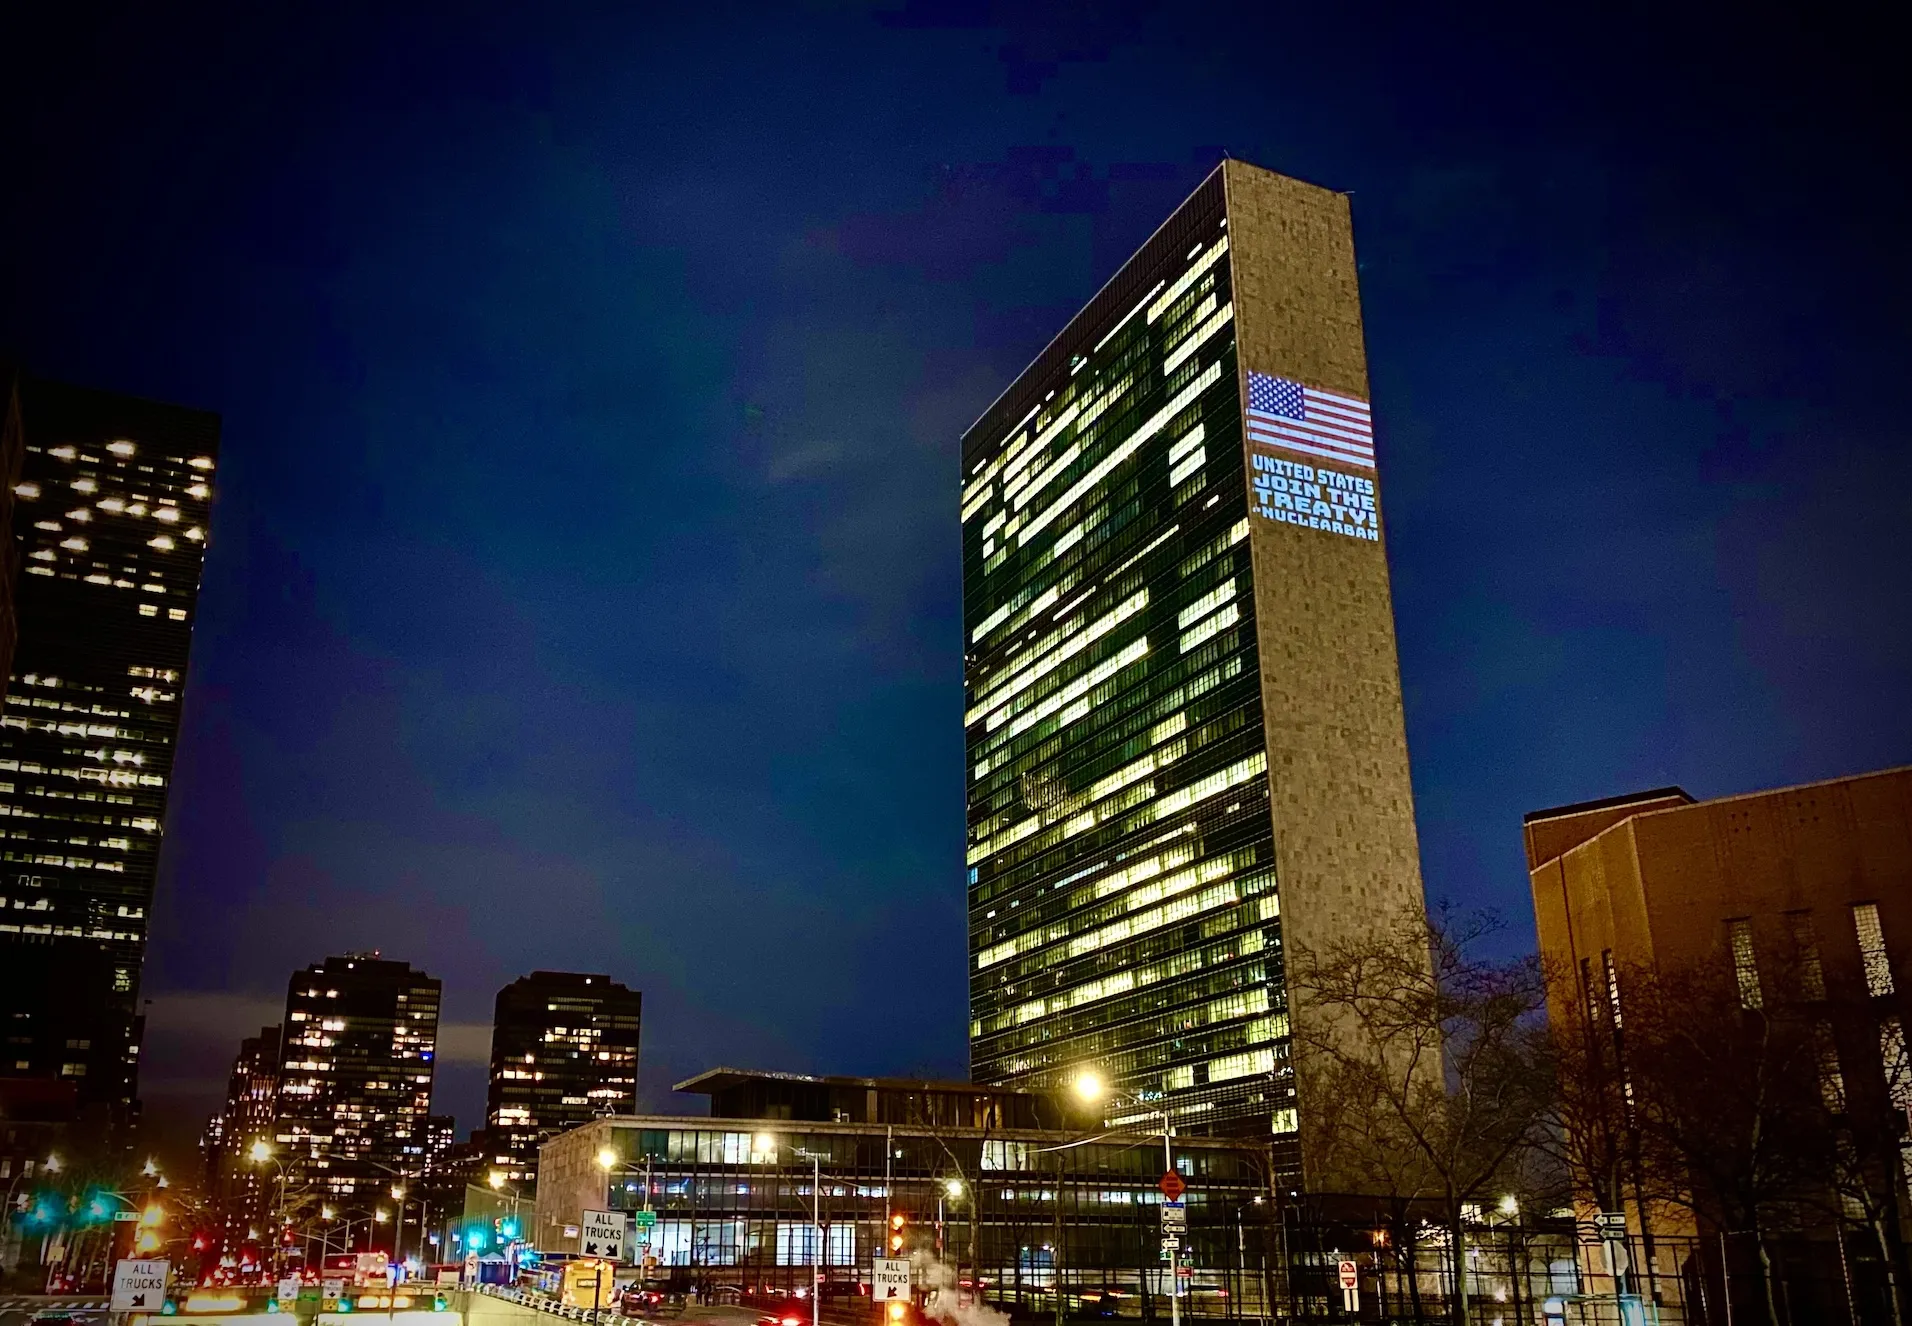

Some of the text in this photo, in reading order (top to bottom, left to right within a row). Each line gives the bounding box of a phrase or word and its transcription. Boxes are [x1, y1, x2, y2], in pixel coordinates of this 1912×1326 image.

[1252, 454, 1374, 496] UNITED STATES
[1253, 473, 1376, 512] JOIN THE
[1253, 487, 1378, 528] TREATY!
[595, 1213, 613, 1225] ALL
[585, 1226, 622, 1240] TRUCKS
[132, 1264, 154, 1274] ALL
[885, 1262, 900, 1271] ALL
[120, 1278, 163, 1289] TRUCKS
[877, 1273, 908, 1284] TRUCKS
